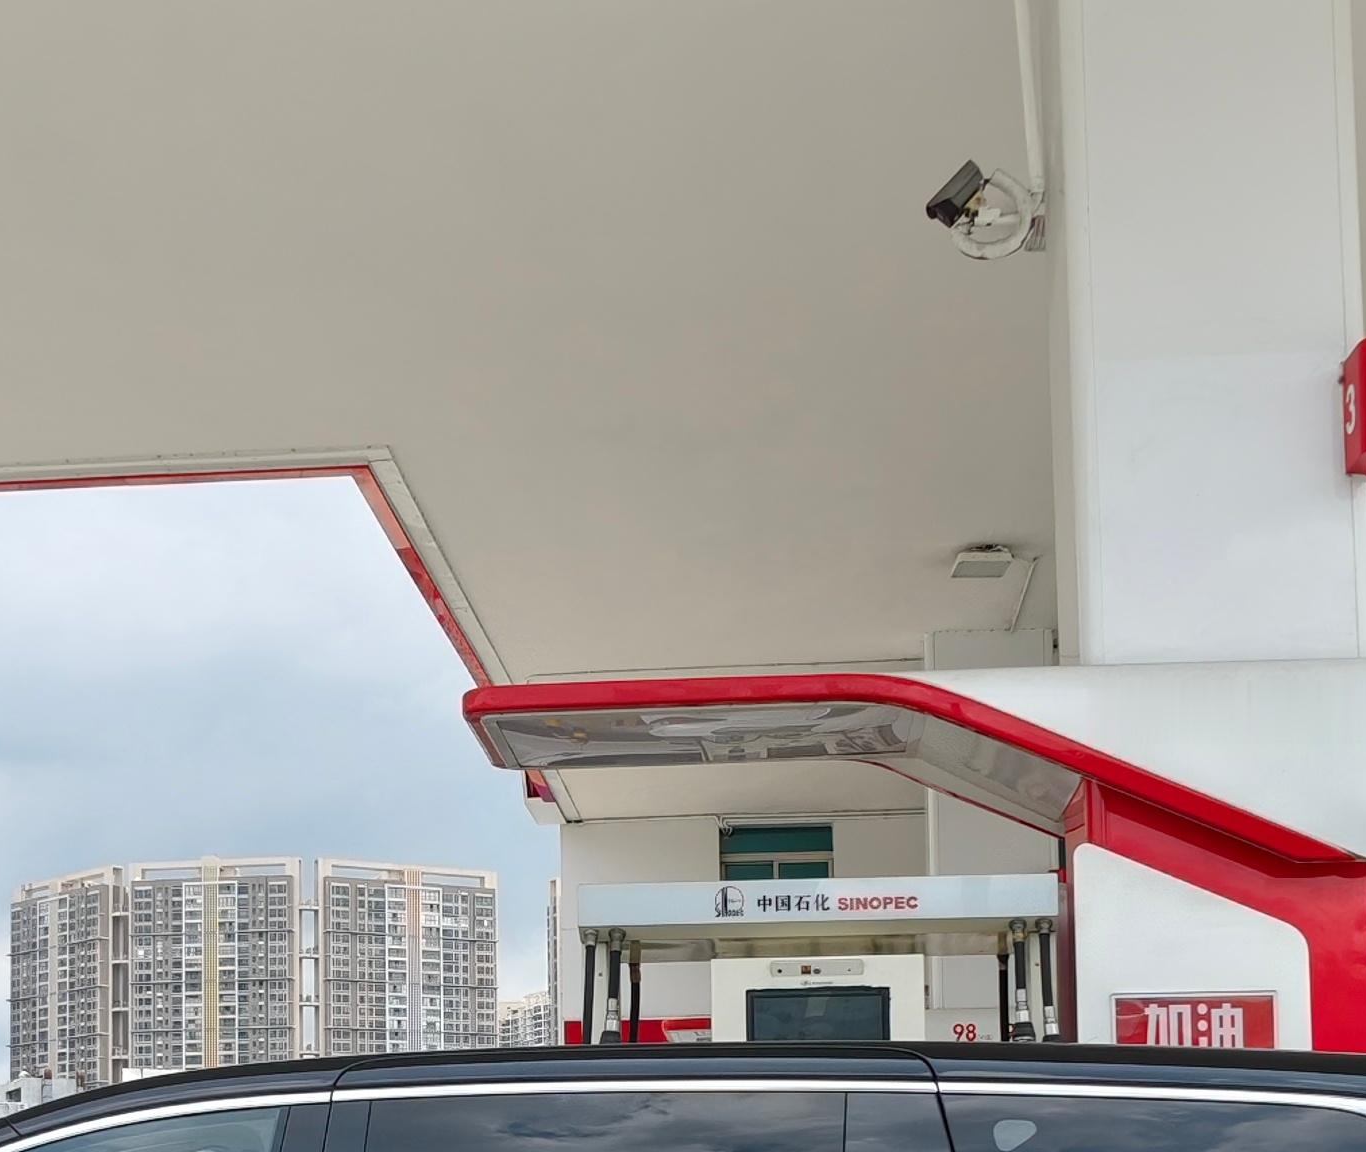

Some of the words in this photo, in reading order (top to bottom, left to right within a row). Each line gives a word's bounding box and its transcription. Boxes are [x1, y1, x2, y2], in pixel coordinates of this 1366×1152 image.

[1345, 383, 1356, 435] 3
[757, 893, 831, 913] 中国石化
[837, 895, 919, 912] SINOPEC
[953, 1023, 977, 1042] 98
[1144, 1002, 1244, 1048] 加油
